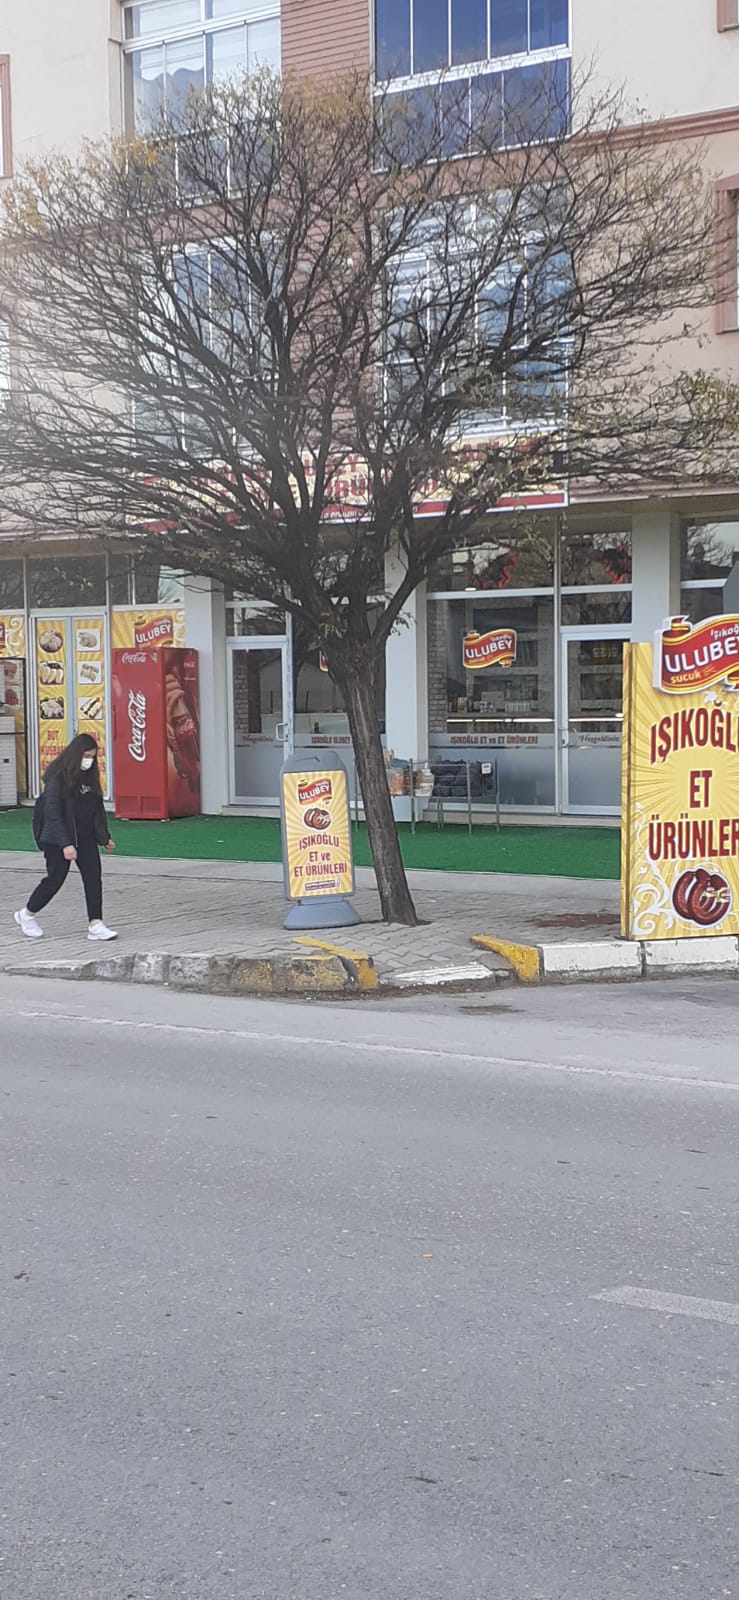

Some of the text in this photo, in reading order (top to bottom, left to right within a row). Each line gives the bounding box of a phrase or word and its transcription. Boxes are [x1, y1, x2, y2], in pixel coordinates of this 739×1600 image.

[135, 623, 172, 643] ULUBEY
[465, 639, 512, 659] ULUBEY
[664, 637, 739, 674] ULUBE
[670, 671, 702, 684] sucuk
[128, 688, 147, 762] Coca-Cola
[650, 699, 739, 765] IŞIKOĞL
[299, 783, 331, 800] ULUBEY
[689, 770, 713, 808] ET
[299, 833, 340, 850] IŞIKOĞLU
[309, 851, 331, 862] ET ve
[294, 861, 348, 877] ET ÜRÜNLERİ
